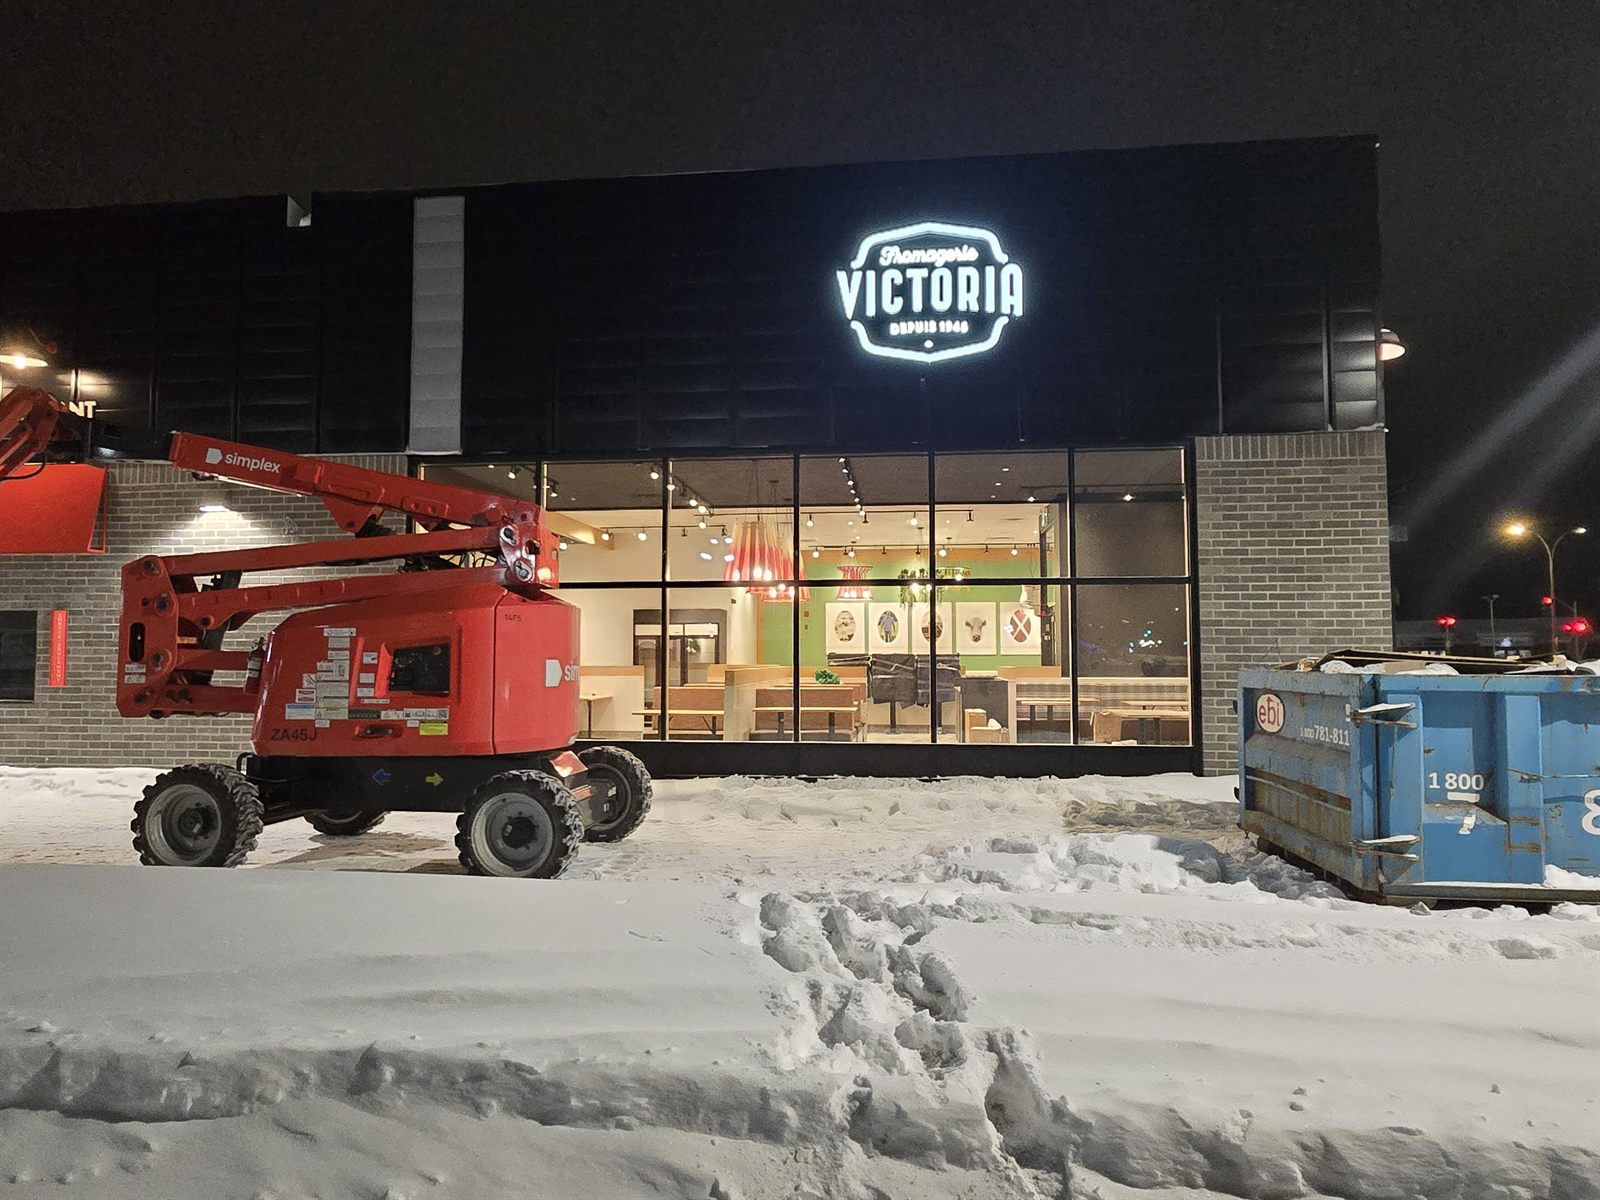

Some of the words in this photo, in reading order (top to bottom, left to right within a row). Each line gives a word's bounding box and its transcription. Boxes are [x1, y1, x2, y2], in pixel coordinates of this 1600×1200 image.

[836, 263, 1023, 320] VICTORIA
[889, 320, 937, 336] DEPUIS
[61, 400, 97, 418] NT
[224, 452, 281, 474] simplex
[270, 727, 318, 741] ZA45J
[1428, 772, 1440, 789] 1
[1444, 772, 1485, 791] 800
